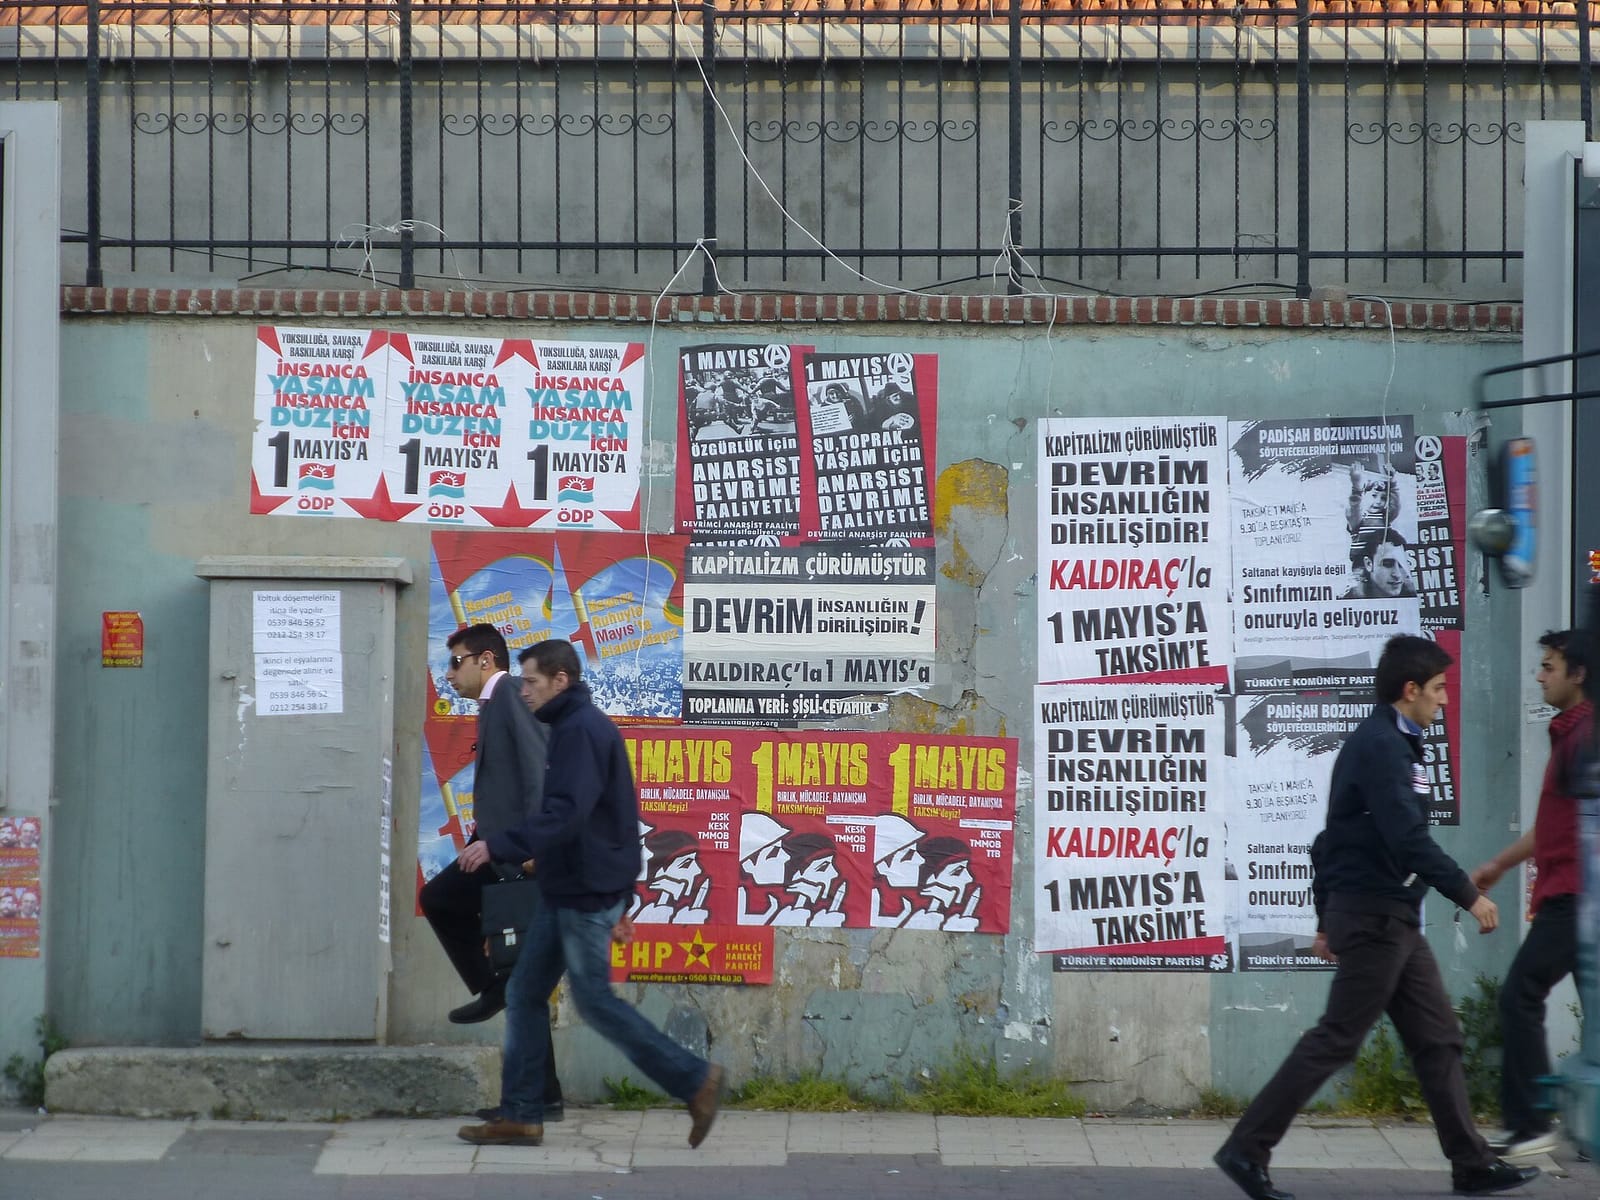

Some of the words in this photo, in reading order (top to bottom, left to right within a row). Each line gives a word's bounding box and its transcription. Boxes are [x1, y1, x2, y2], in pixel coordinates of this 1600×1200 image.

[282, 334, 330, 346] YOKSULLUĞA,
[332, 336, 363, 348] SAVAŞA,
[415, 340, 461, 354] YOKSULLUĞA,
[465, 344, 495, 357] SAVAŞA,
[290, 348, 330, 358] BASKILARA
[422, 355, 462, 366] BASKILARA
[539, 346, 586, 360] YOKSULLUĞA,
[589, 348, 620, 361] SAVAŞA,
[682, 354, 690, 371] 1
[277, 358, 368, 378] İNSANCA
[547, 360, 587, 371] BASKILARA
[806, 363, 814, 380] 1
[409, 366, 499, 388] İNSANCA
[535, 372, 624, 391] İNSANCA
[276, 390, 366, 410] İNSANCA
[407, 397, 498, 418] İNSANCA
[271, 405, 370, 428] DÜZEN
[534, 403, 624, 422] İNSANCA
[332, 422, 369, 440] İÇİN
[402, 412, 502, 436] DÜZEN
[530, 418, 627, 441] DÜZEN
[463, 429, 500, 448] İÇİN
[591, 434, 627, 452] İÇİN
[1045, 429, 1121, 457] KAPİTALİZM
[1127, 423, 1217, 456] ÇÜRÜMÜŞTÜR
[1259, 426, 1310, 446] PADİŞAH
[1314, 424, 1402, 441] BOZUNTUSUNA
[691, 438, 763, 457] ÖZGÜRLÜK
[768, 437, 796, 452] için
[1340, 443, 1386, 455] HAYKIRMAK
[268, 431, 290, 487] 1
[294, 440, 368, 461] MAYIS'A
[399, 439, 420, 494] 1
[424, 447, 498, 469] MAYIS'A
[814, 449, 877, 470] YAŞAM
[883, 447, 920, 465] için
[527, 445, 548, 500] 1
[552, 452, 626, 473] MAYIS'A
[1052, 455, 1208, 486] DEVRİM
[298, 496, 334, 510] ÖDP
[428, 503, 464, 518] ÖDP
[1052, 486, 1209, 515] İNSANLIĞIN
[558, 508, 594, 522] ÖDP
[1052, 518, 1208, 548] DİRİLİŞİDİR!
[692, 550, 799, 575] KAPİTALİZM
[805, 552, 927, 581] ÇÜRÜMÜŞTÜR
[1242, 567, 1280, 578] Saltanat
[1282, 566, 1322, 577] kayığıyla
[1324, 565, 1346, 576] değil
[1050, 556, 1211, 598] KALDIRAÇ'la
[1244, 584, 1332, 604] Sınıfımızın
[818, 598, 908, 613] İNSANLIĞIN
[1047, 612, 1063, 643] 1
[1072, 601, 1208, 642] MAYIS'A
[1244, 609, 1318, 629] onuruyla
[1323, 608, 1398, 628] geliyoruz
[595, 624, 635, 643] Mayıs
[1096, 638, 1210, 676] TAKSİM'E
[688, 661, 822, 688] KALDIRAÇ'la
[826, 660, 833, 682] 1
[844, 659, 930, 683] MAYIS'a
[1245, 677, 1290, 687] TÜRKİYE
[1293, 675, 1346, 686] KOMÜNİST
[688, 697, 754, 714] TOPLANMA
[758, 694, 789, 714] YERİ:
[1041, 696, 1118, 723] KAPİTALİZM
[1122, 691, 1214, 724] ÇÜRÜMÜŞTÜR
[1267, 702, 1319, 721] PADİŞAH
[1048, 724, 1205, 753] DEVRİM
[641, 740, 732, 783] MAYIS
[1048, 754, 1207, 782] İNSANLIĞIN
[752, 742, 773, 814] 1
[778, 742, 868, 786] MAYIS
[888, 744, 910, 817] 1
[915, 745, 1006, 791] MAYIS
[1048, 786, 1206, 816] DİRİLİŞİDİR!
[834, 834, 866, 842] TMMOB
[970, 839, 1002, 848] TMMOB
[980, 830, 1002, 839] KESK
[851, 844, 866, 852] TTB
[1047, 824, 1208, 867] KALDIRAÇ'la
[1248, 844, 1284, 854] Saltanat
[1044, 879, 1060, 912] 1
[1069, 870, 1205, 911] MAYIS'A
[1092, 908, 1206, 945] TAKSİM'E
[611, 942, 672, 968] EHP
[1061, 954, 1106, 966] TÜRKİYE
[1108, 954, 1163, 966] KOMÜNİST
[1165, 954, 1204, 966] PARTİSİ
[1248, 955, 1293, 965] TÜRKİYE
